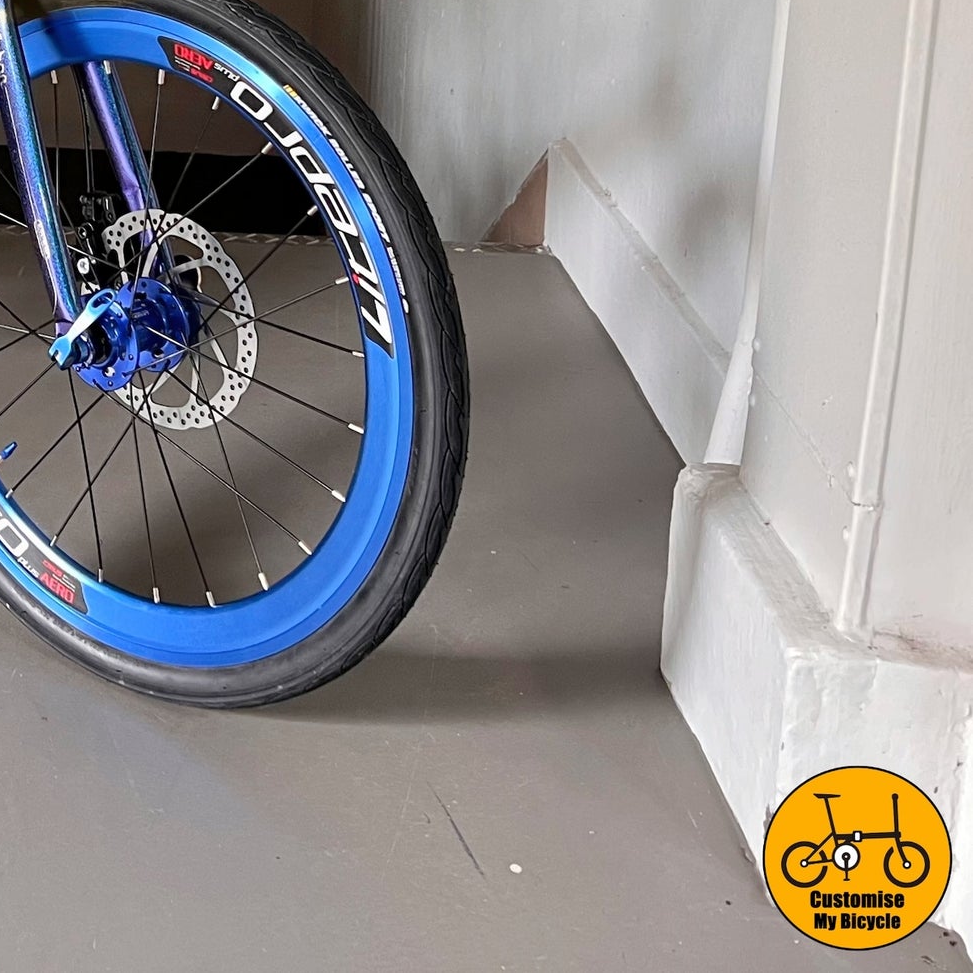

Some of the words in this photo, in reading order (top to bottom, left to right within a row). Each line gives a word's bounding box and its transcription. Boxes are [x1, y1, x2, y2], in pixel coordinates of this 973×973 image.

[174, 43, 214, 70] AERO
[230, 80, 393, 344] Litepro
[40, 572, 75, 605] AERO
